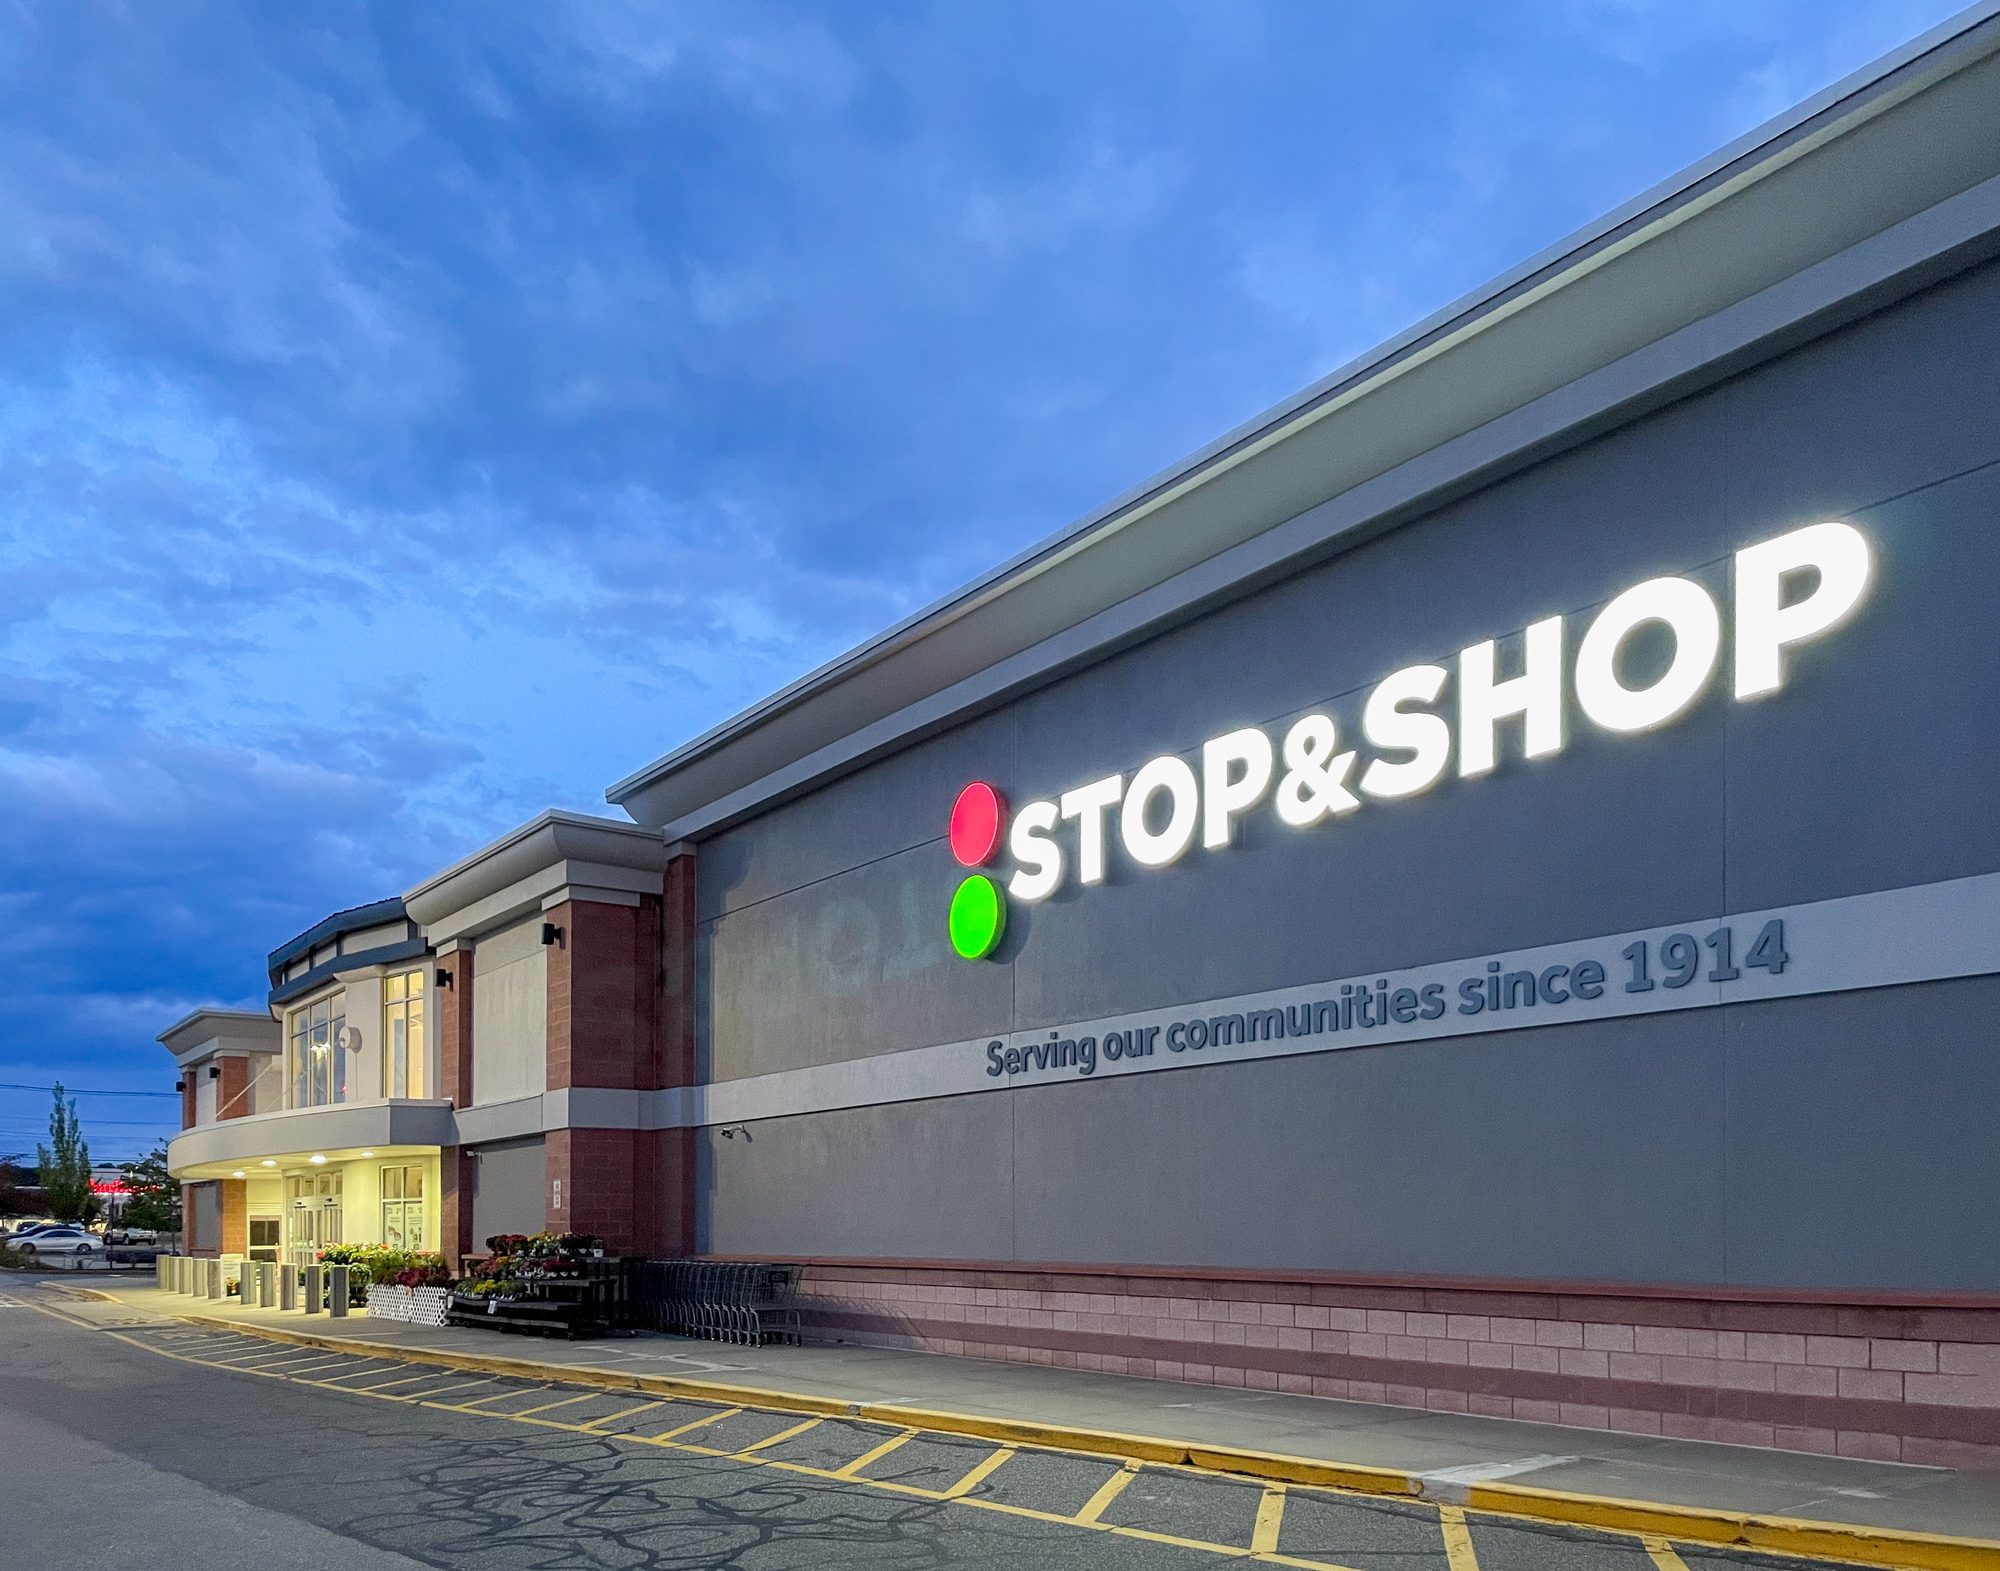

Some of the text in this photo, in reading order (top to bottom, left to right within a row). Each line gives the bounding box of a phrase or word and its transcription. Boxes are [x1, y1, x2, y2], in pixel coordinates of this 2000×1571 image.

[1008, 521, 1872, 902] STOP&SHOP
[986, 918, 1788, 1076] Serving our communities since 1914
